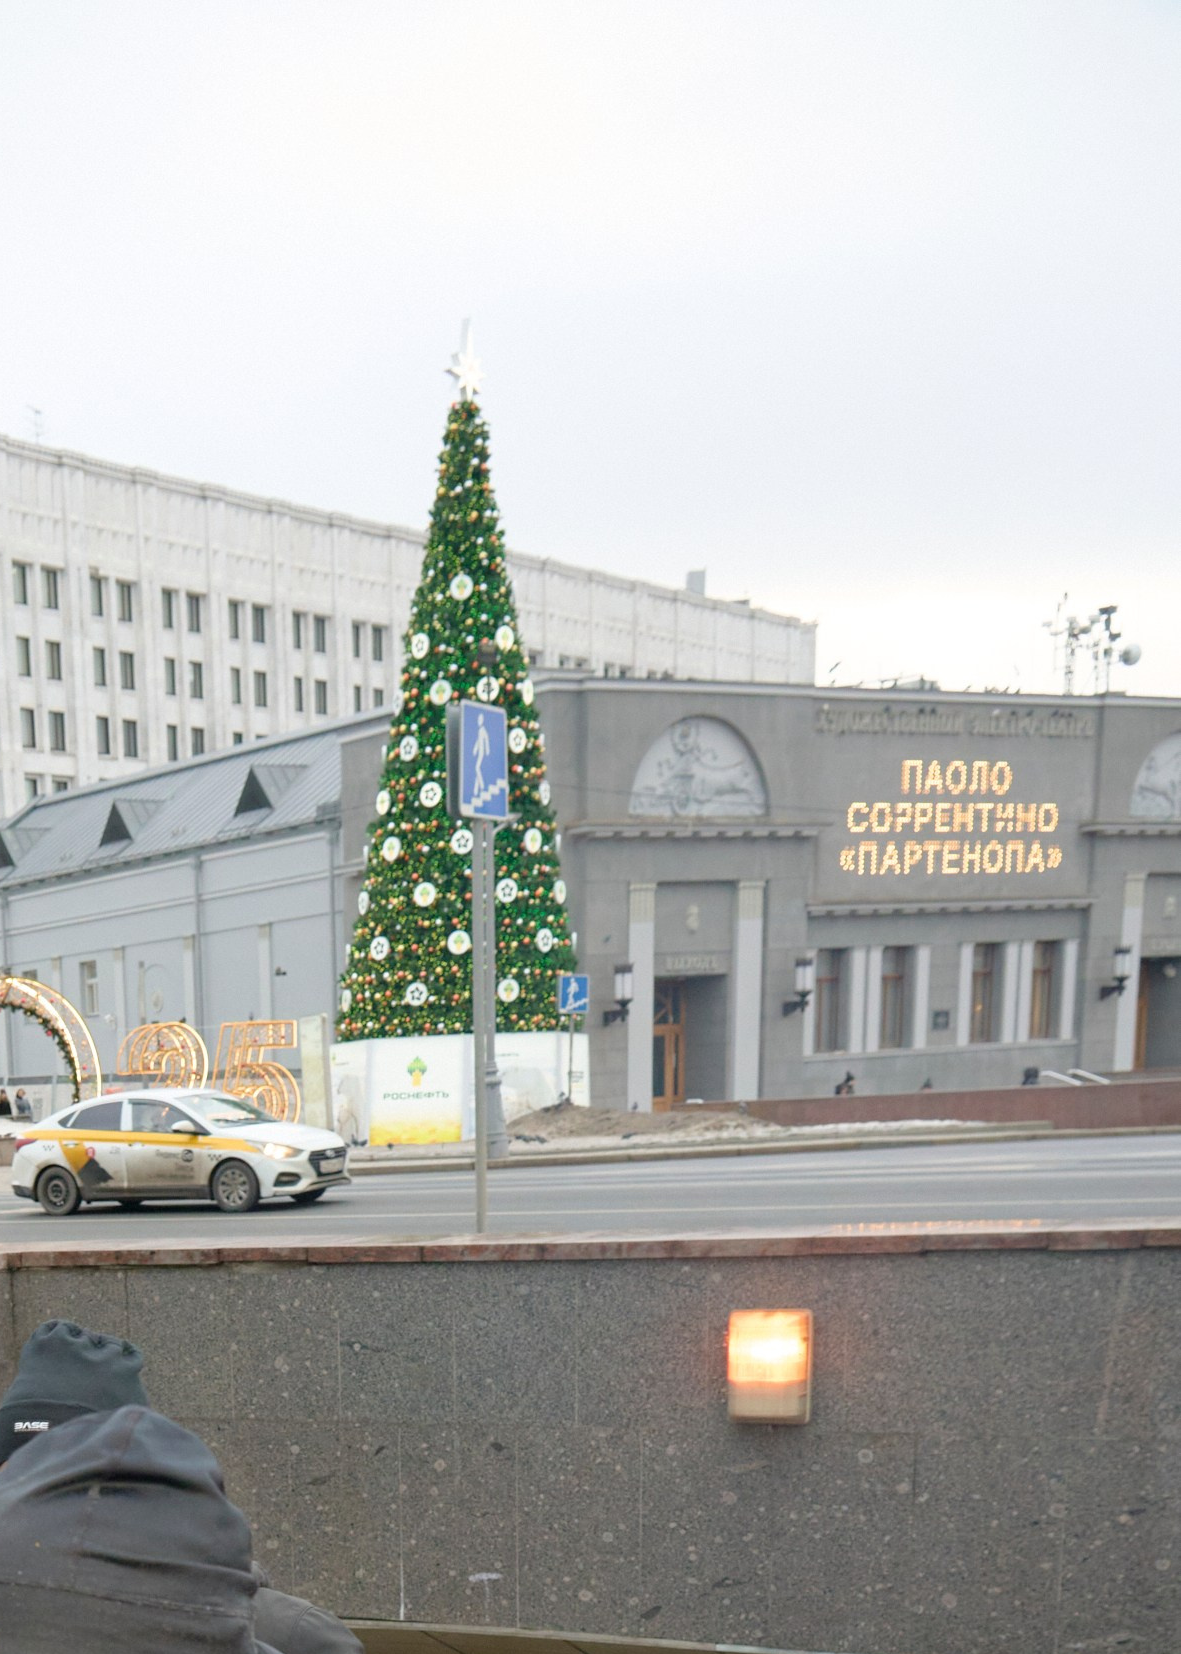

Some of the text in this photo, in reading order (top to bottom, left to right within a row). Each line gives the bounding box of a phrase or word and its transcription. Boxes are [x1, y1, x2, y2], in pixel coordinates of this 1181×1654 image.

[901, 760, 1013, 795] ПАОЛО
[847, 802, 1059, 832] СОРРЕНТИНО
[839, 840, 1063, 875] «ПАРТЕНОПА»
[382, 1091, 450, 1101] РОСНЕФТЬ
[14, 1421, 49, 1430] BASE
